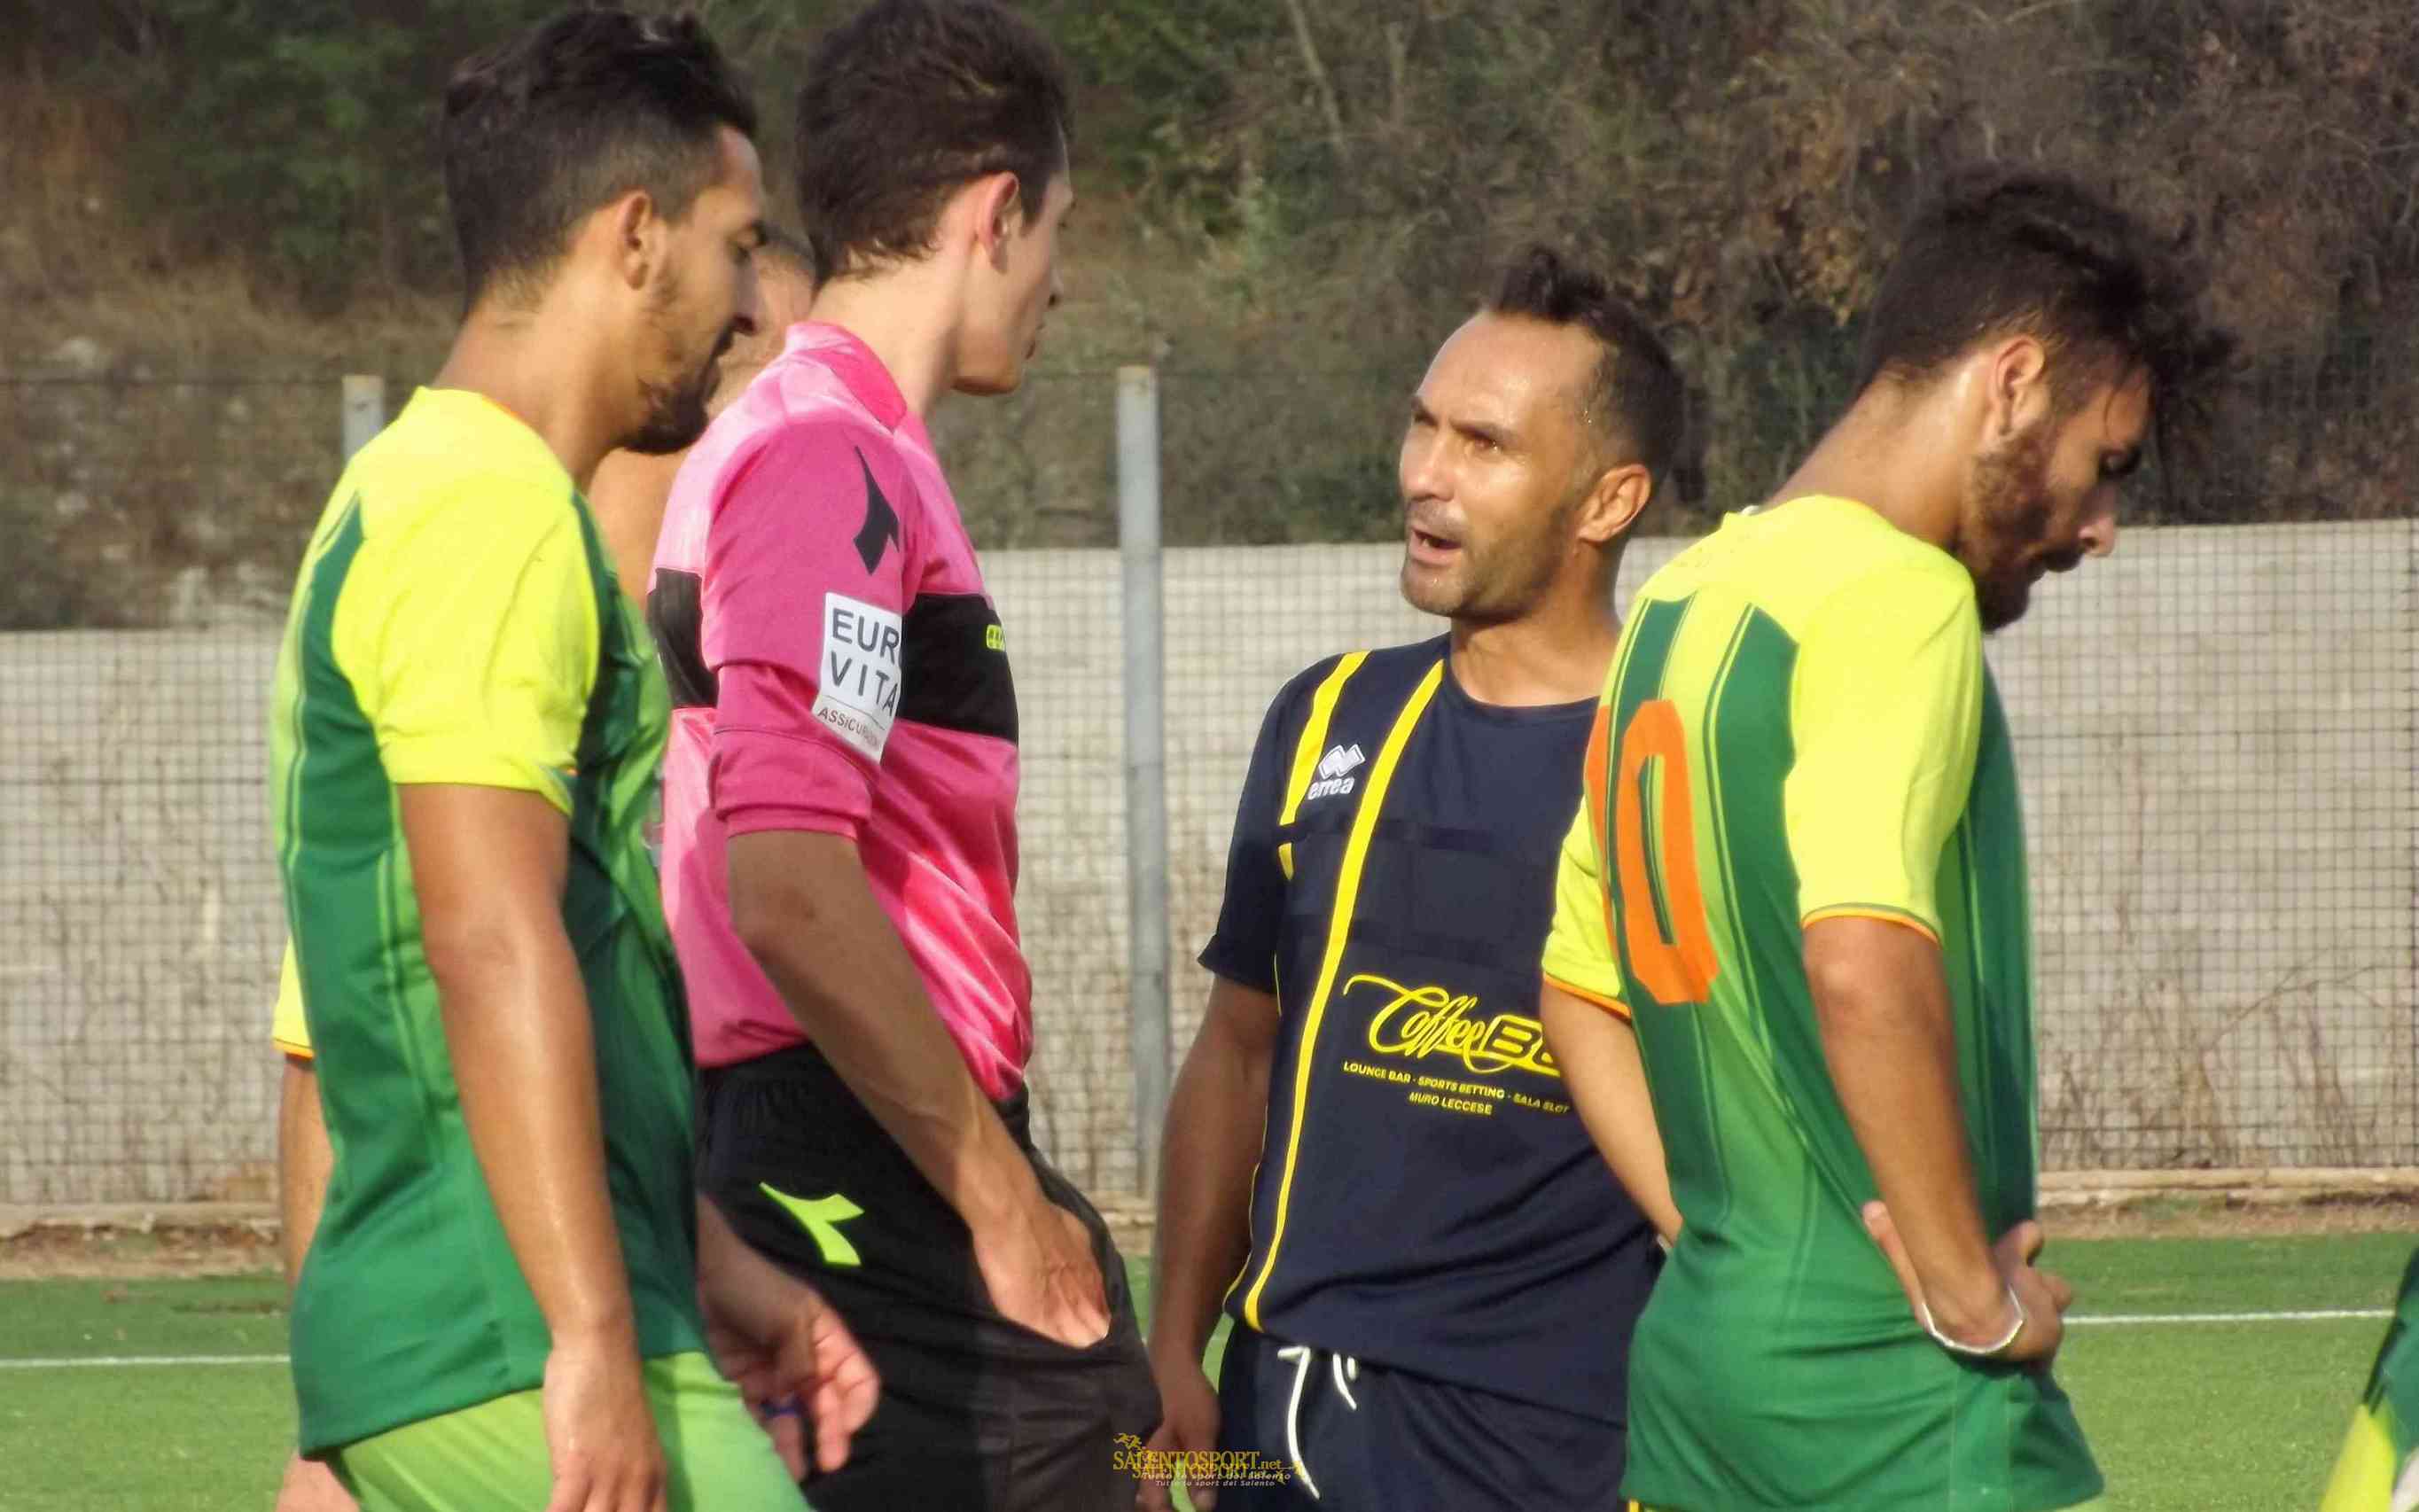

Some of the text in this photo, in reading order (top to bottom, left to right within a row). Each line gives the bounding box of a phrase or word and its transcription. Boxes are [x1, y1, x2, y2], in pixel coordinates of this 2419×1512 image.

[831, 651, 898, 718] VITA
[1343, 1061, 1571, 1114] LOUNGE BAR SPORTS BETTING SALA SLOT
[1408, 1091, 1494, 1116] MURO LECCESE
